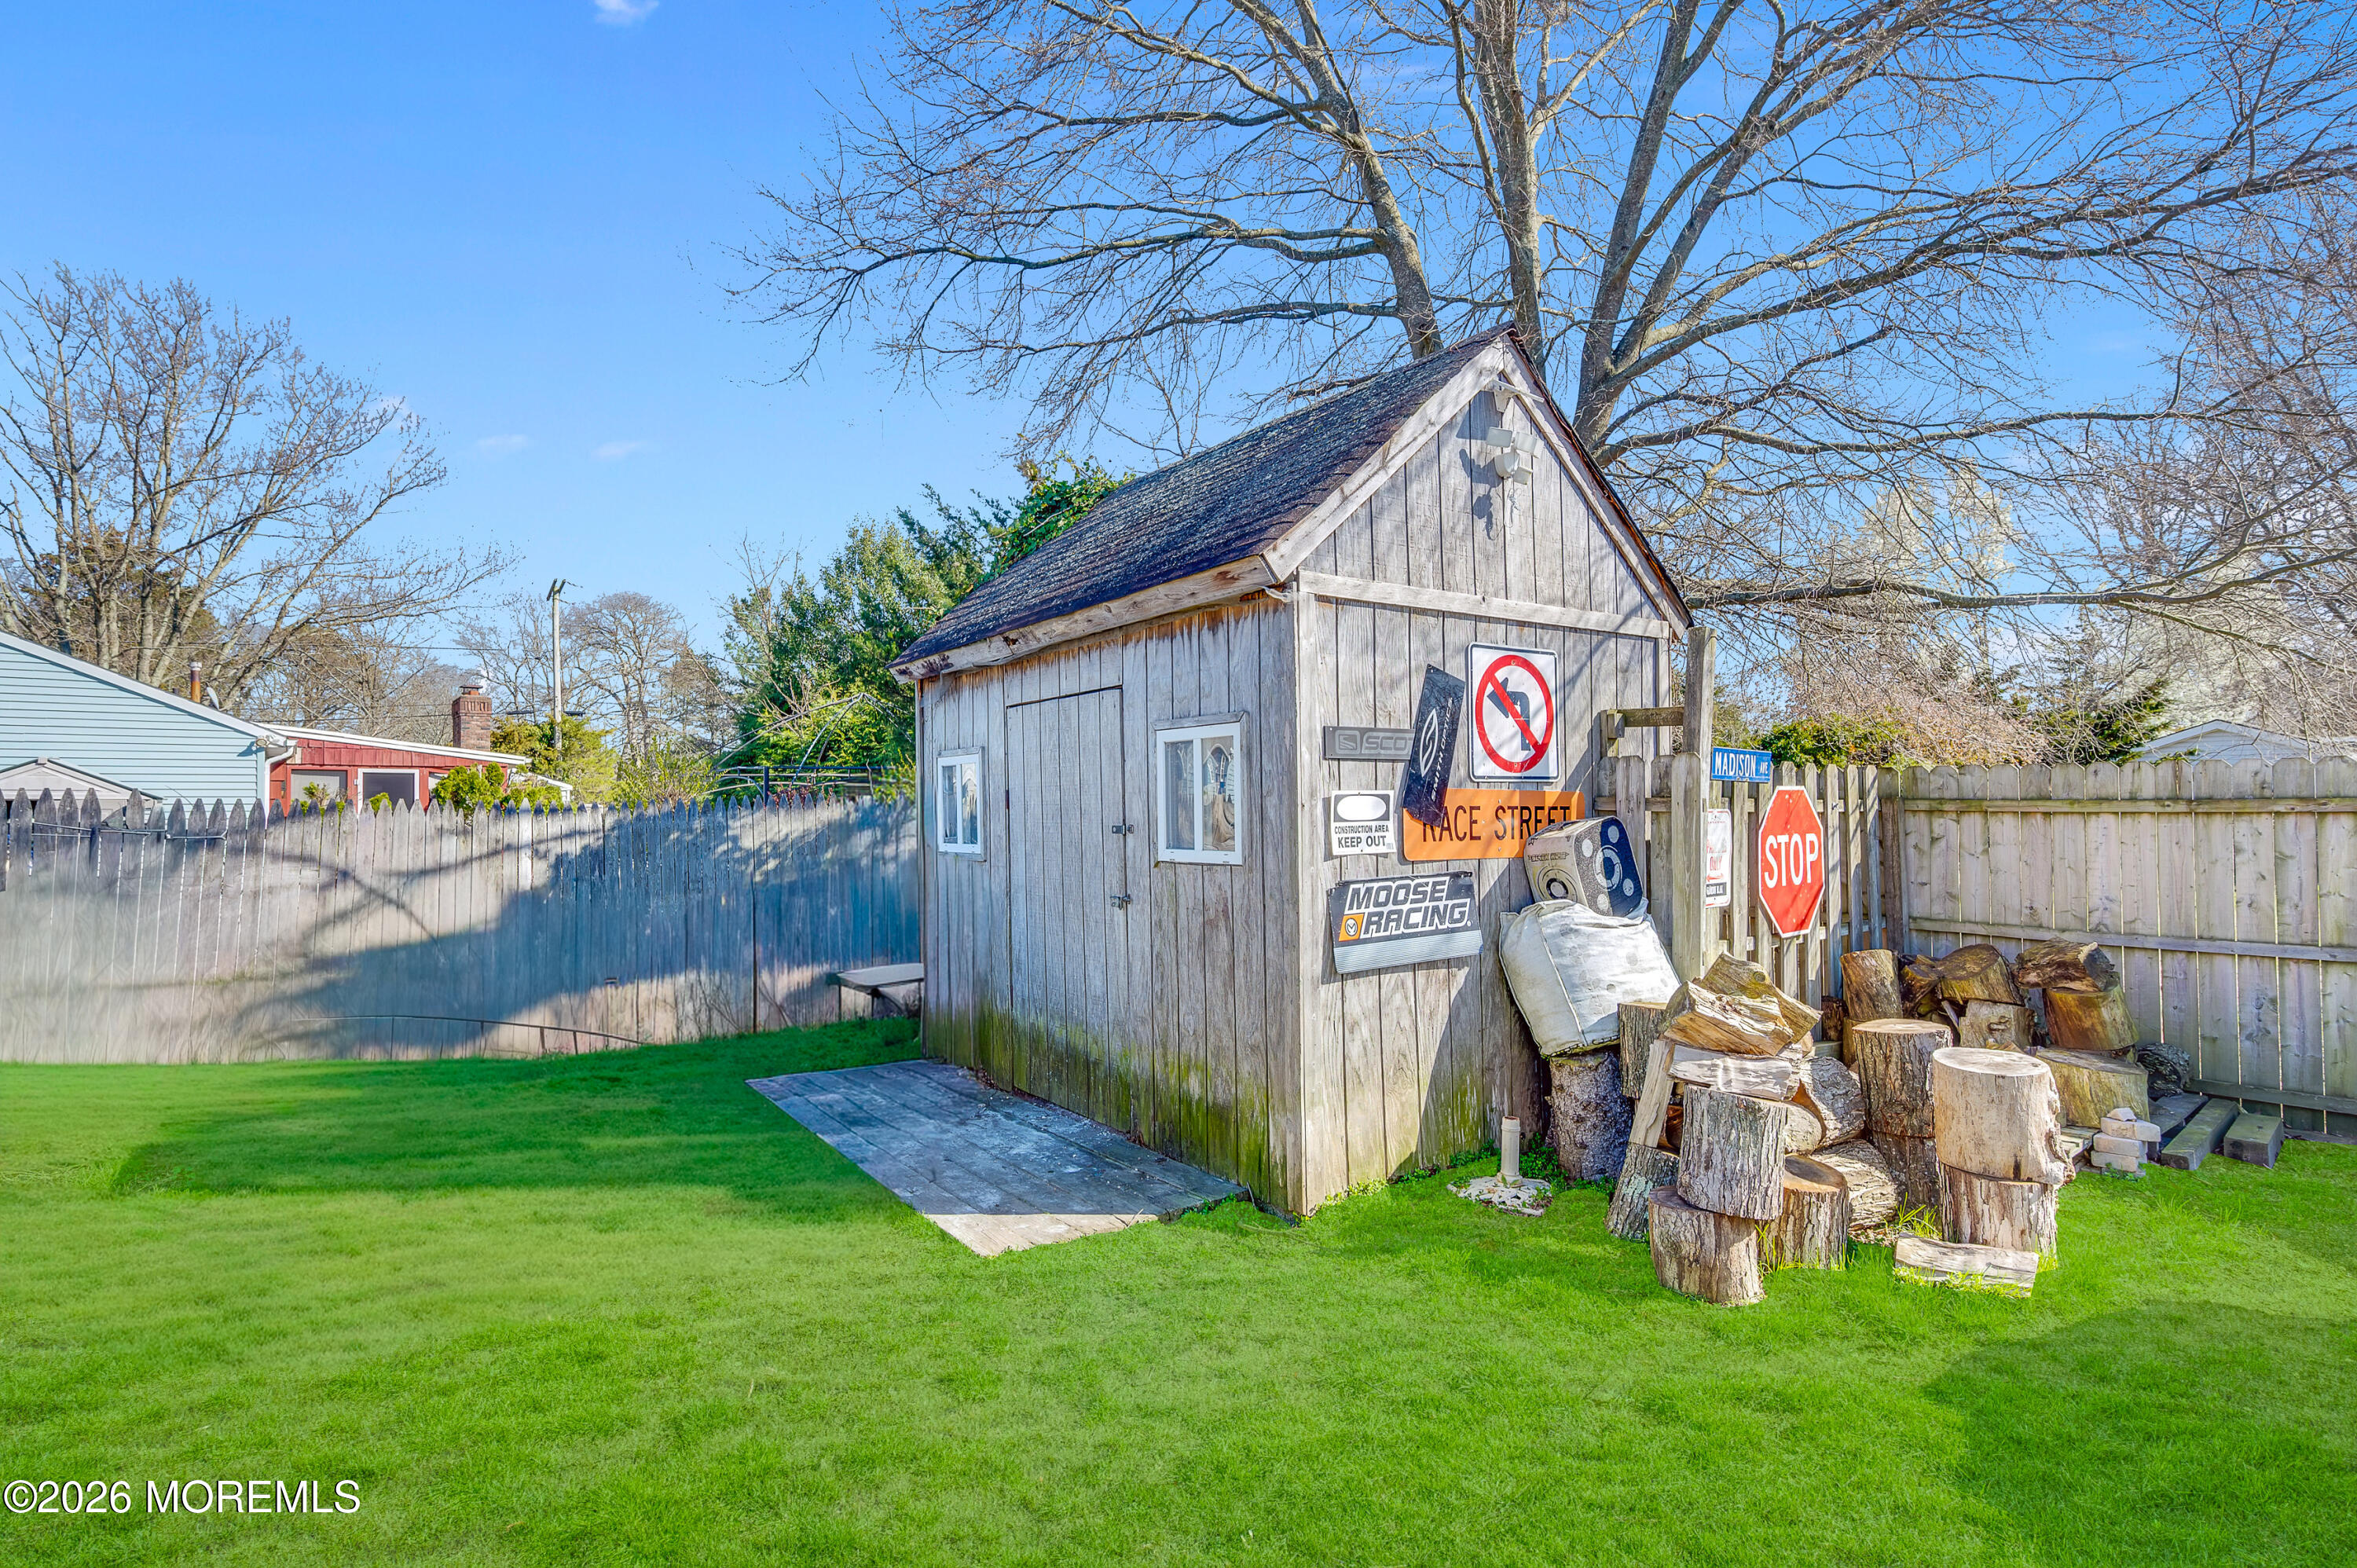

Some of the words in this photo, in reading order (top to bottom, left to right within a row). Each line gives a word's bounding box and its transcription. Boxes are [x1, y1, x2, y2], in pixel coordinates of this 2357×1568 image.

[1431, 752, 1443, 802] SMITH
[1441, 697, 1453, 749] OPTICS
[1714, 751, 1756, 777] MADISON
[1759, 761, 1769, 775] AVE
[1335, 825, 1373, 834] CONSTRUCTION
[1374, 824, 1389, 833] AREA
[1338, 836, 1362, 848] KEEP
[1365, 835, 1387, 847] OUT
[1764, 833, 1819, 888] STOP
[1347, 878, 1447, 911] MOOSE
